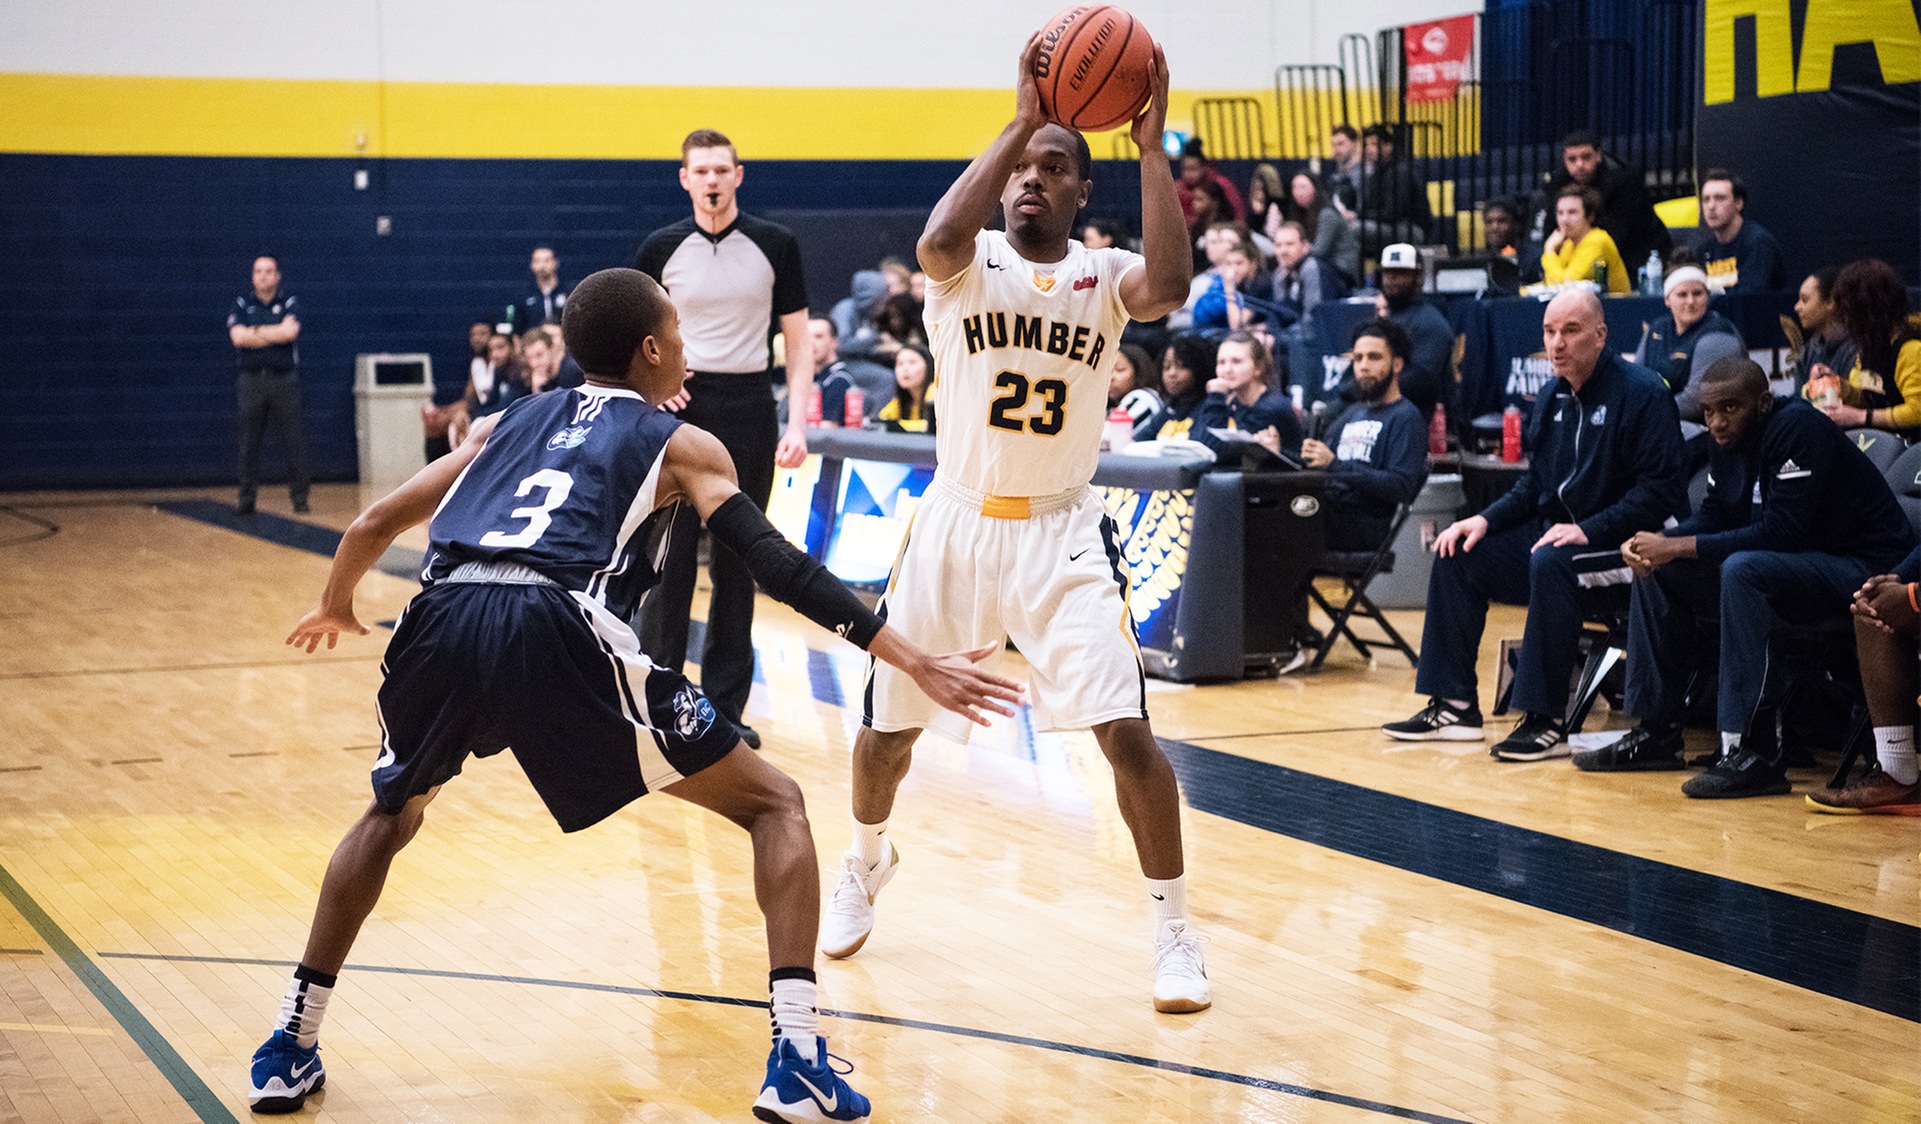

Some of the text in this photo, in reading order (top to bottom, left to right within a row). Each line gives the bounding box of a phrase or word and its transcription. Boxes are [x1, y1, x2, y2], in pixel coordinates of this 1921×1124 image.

[1036, 7, 1090, 79] Wilson
[1070, 18, 1117, 91] EVOLUTION
[963, 312, 1106, 371] HUMBER
[988, 369, 1069, 436] 23
[479, 469, 574, 548] 3
